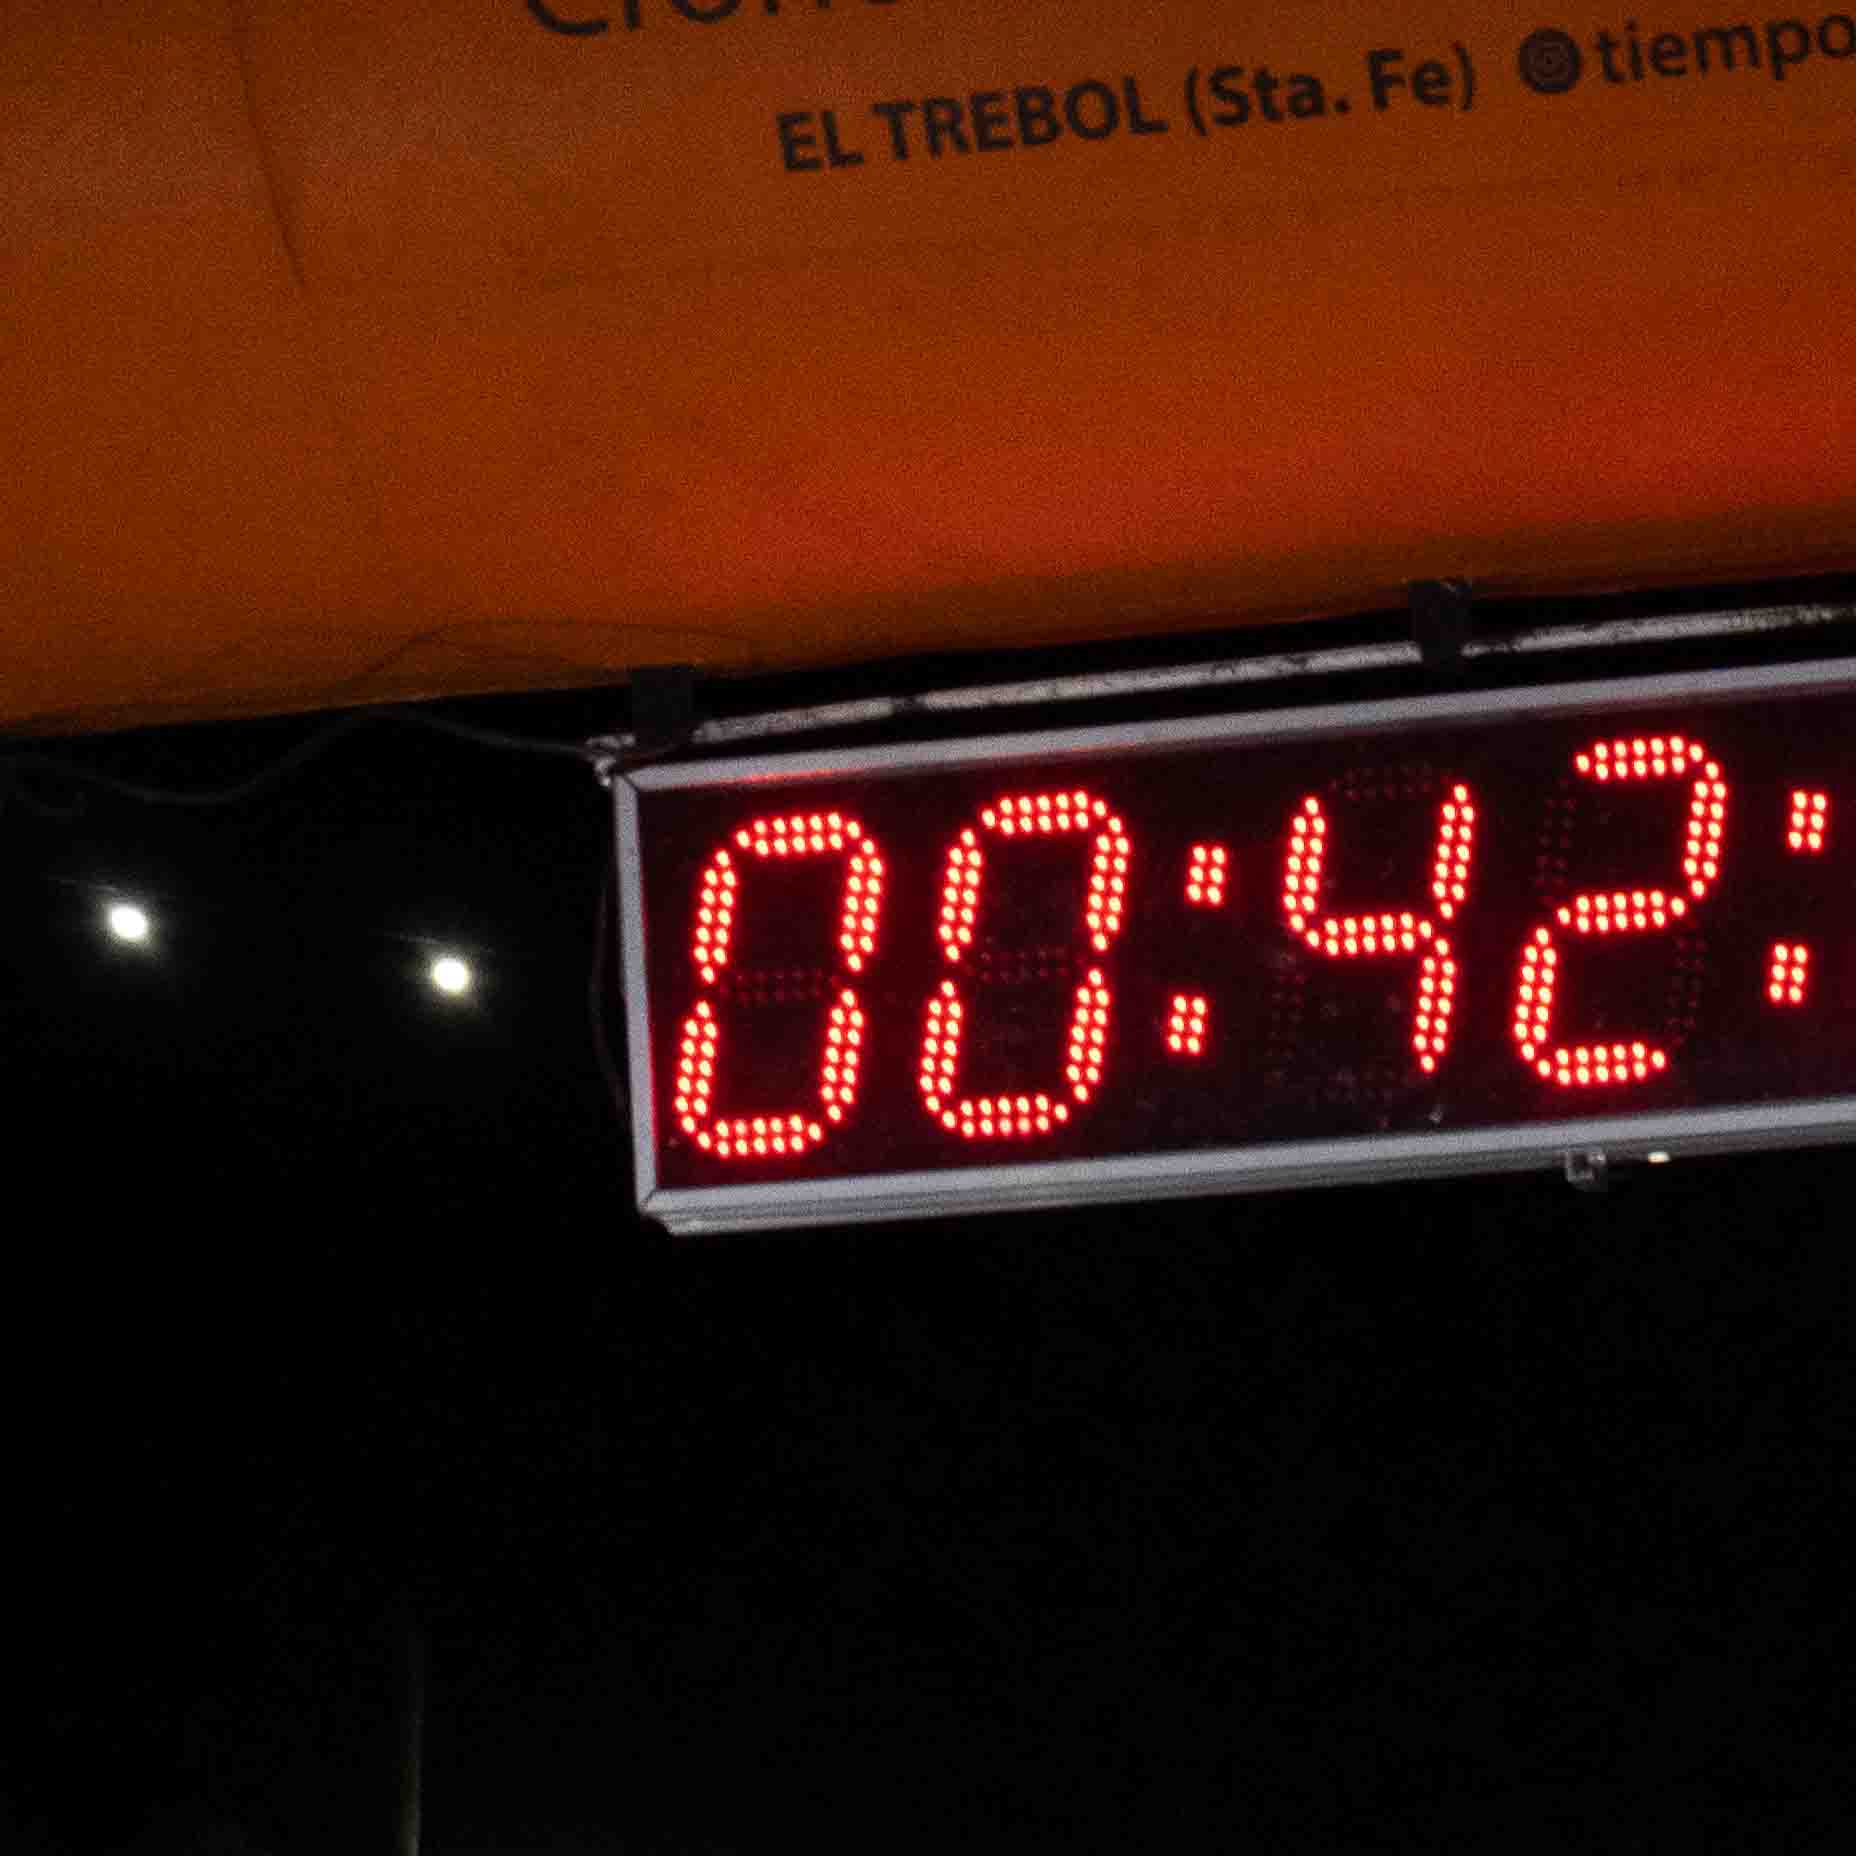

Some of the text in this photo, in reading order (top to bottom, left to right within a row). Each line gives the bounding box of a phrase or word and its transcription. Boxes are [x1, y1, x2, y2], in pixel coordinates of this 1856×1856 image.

[776, 40, 1477, 173] EL TREBOL (Sta. Fe)
